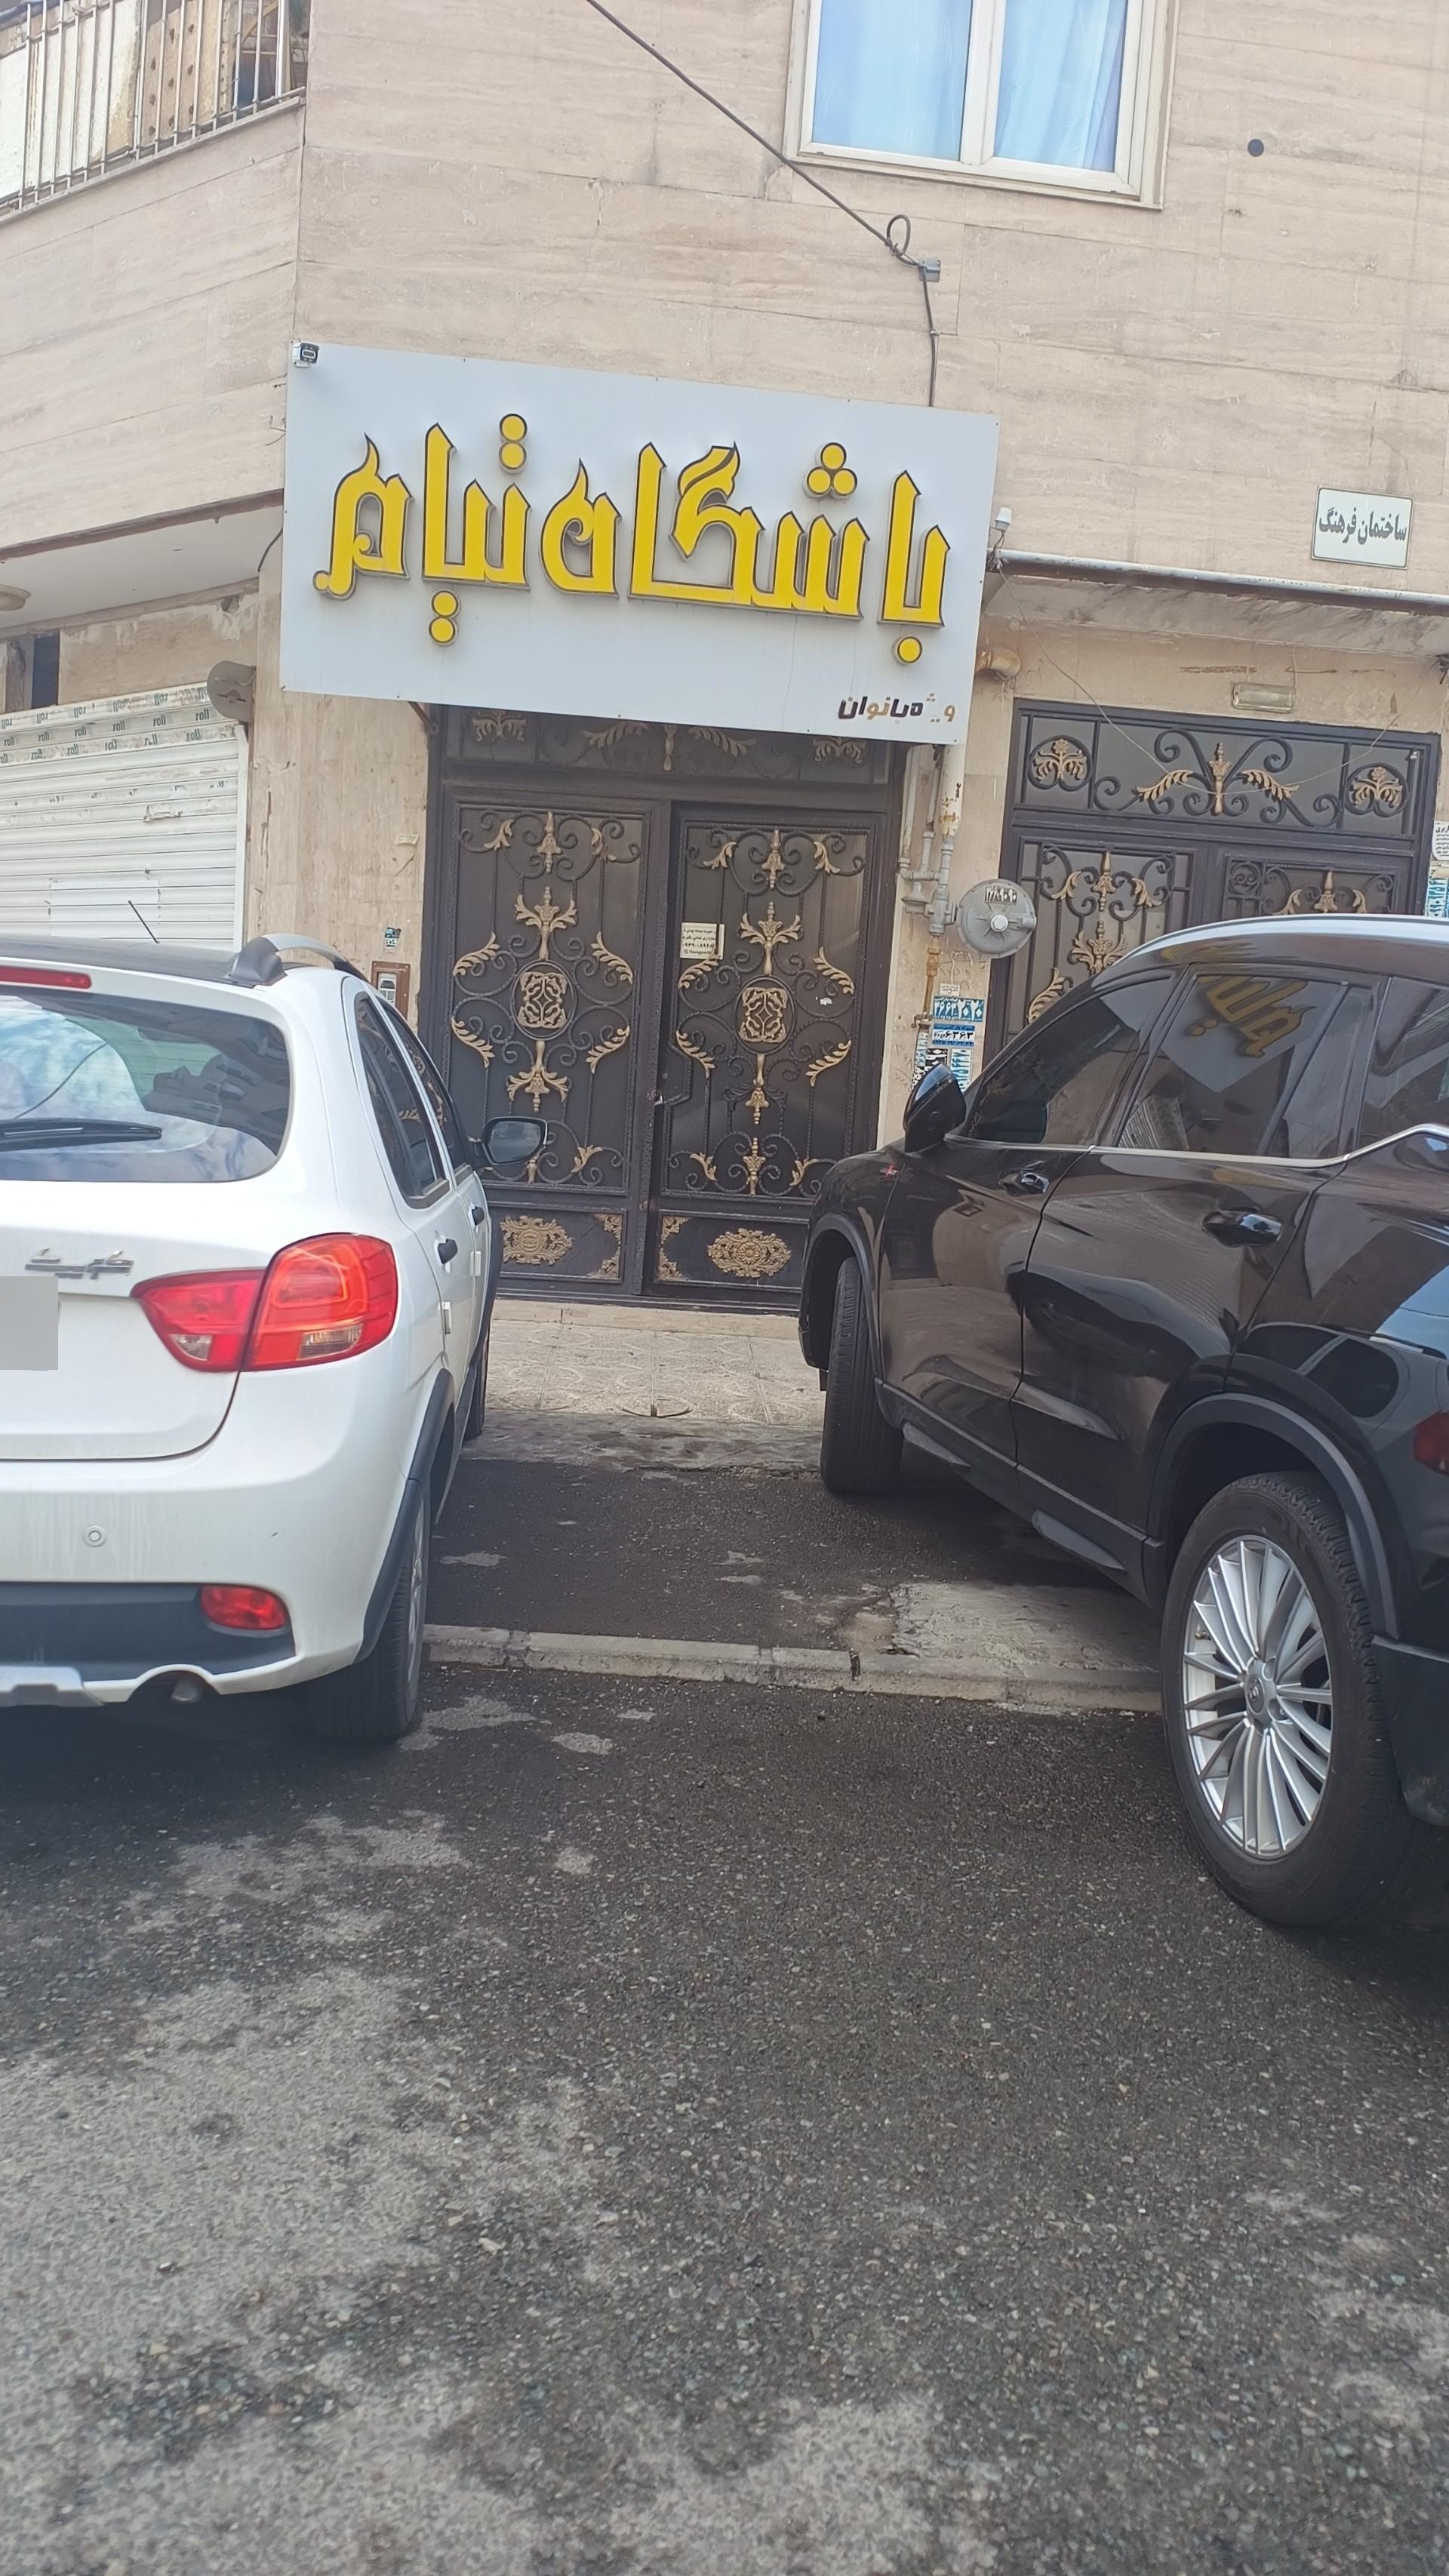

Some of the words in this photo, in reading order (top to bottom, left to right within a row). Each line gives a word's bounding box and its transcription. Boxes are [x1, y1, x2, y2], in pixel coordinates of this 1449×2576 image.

[312, 413, 531, 646] تیام
[1319, 506, 1357, 543] فرهنگ
[1358, 511, 1407, 545] ساختمان
[540, 442, 950, 664] باشگاه
[75, 726, 87, 737] roll
[112, 721, 125, 731] roll
[152, 714, 166, 727] roll
[195, 708, 210, 721] roll
[838, 696, 909, 724] بانوان
